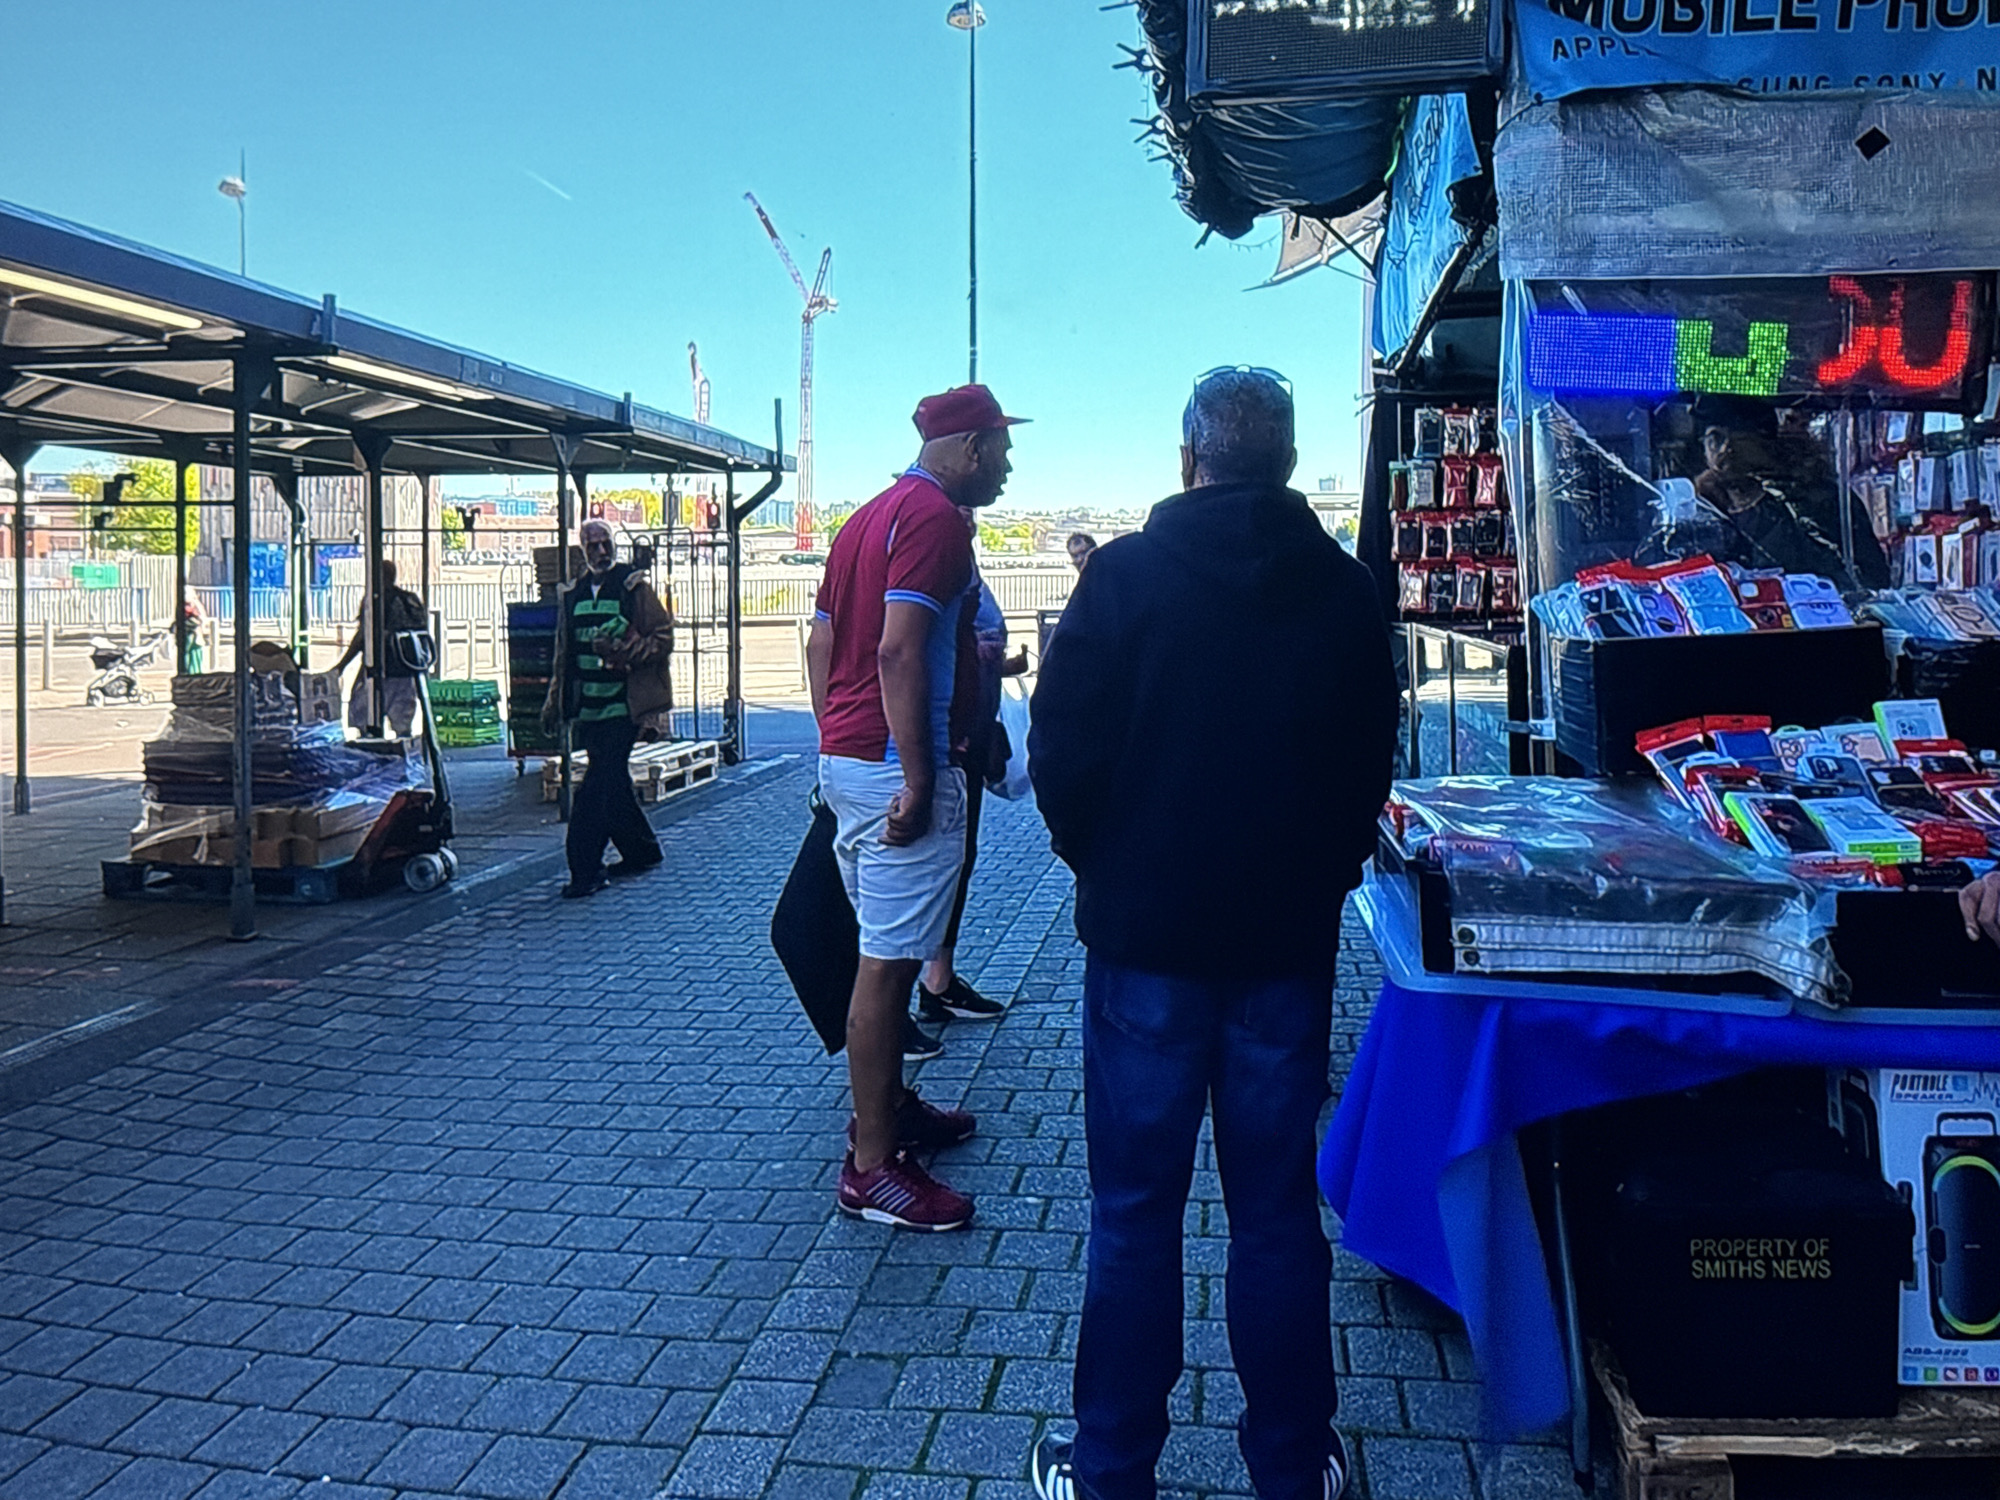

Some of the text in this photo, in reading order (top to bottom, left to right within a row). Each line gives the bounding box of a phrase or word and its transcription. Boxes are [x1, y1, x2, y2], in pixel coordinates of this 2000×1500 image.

[1552, 36, 1662, 62] APPL
[1853, 71, 1947, 90] SONY
[1690, 1238, 1830, 1258] PROPERTY OF
[1691, 1259, 1832, 1279] SMITHS NEWS
